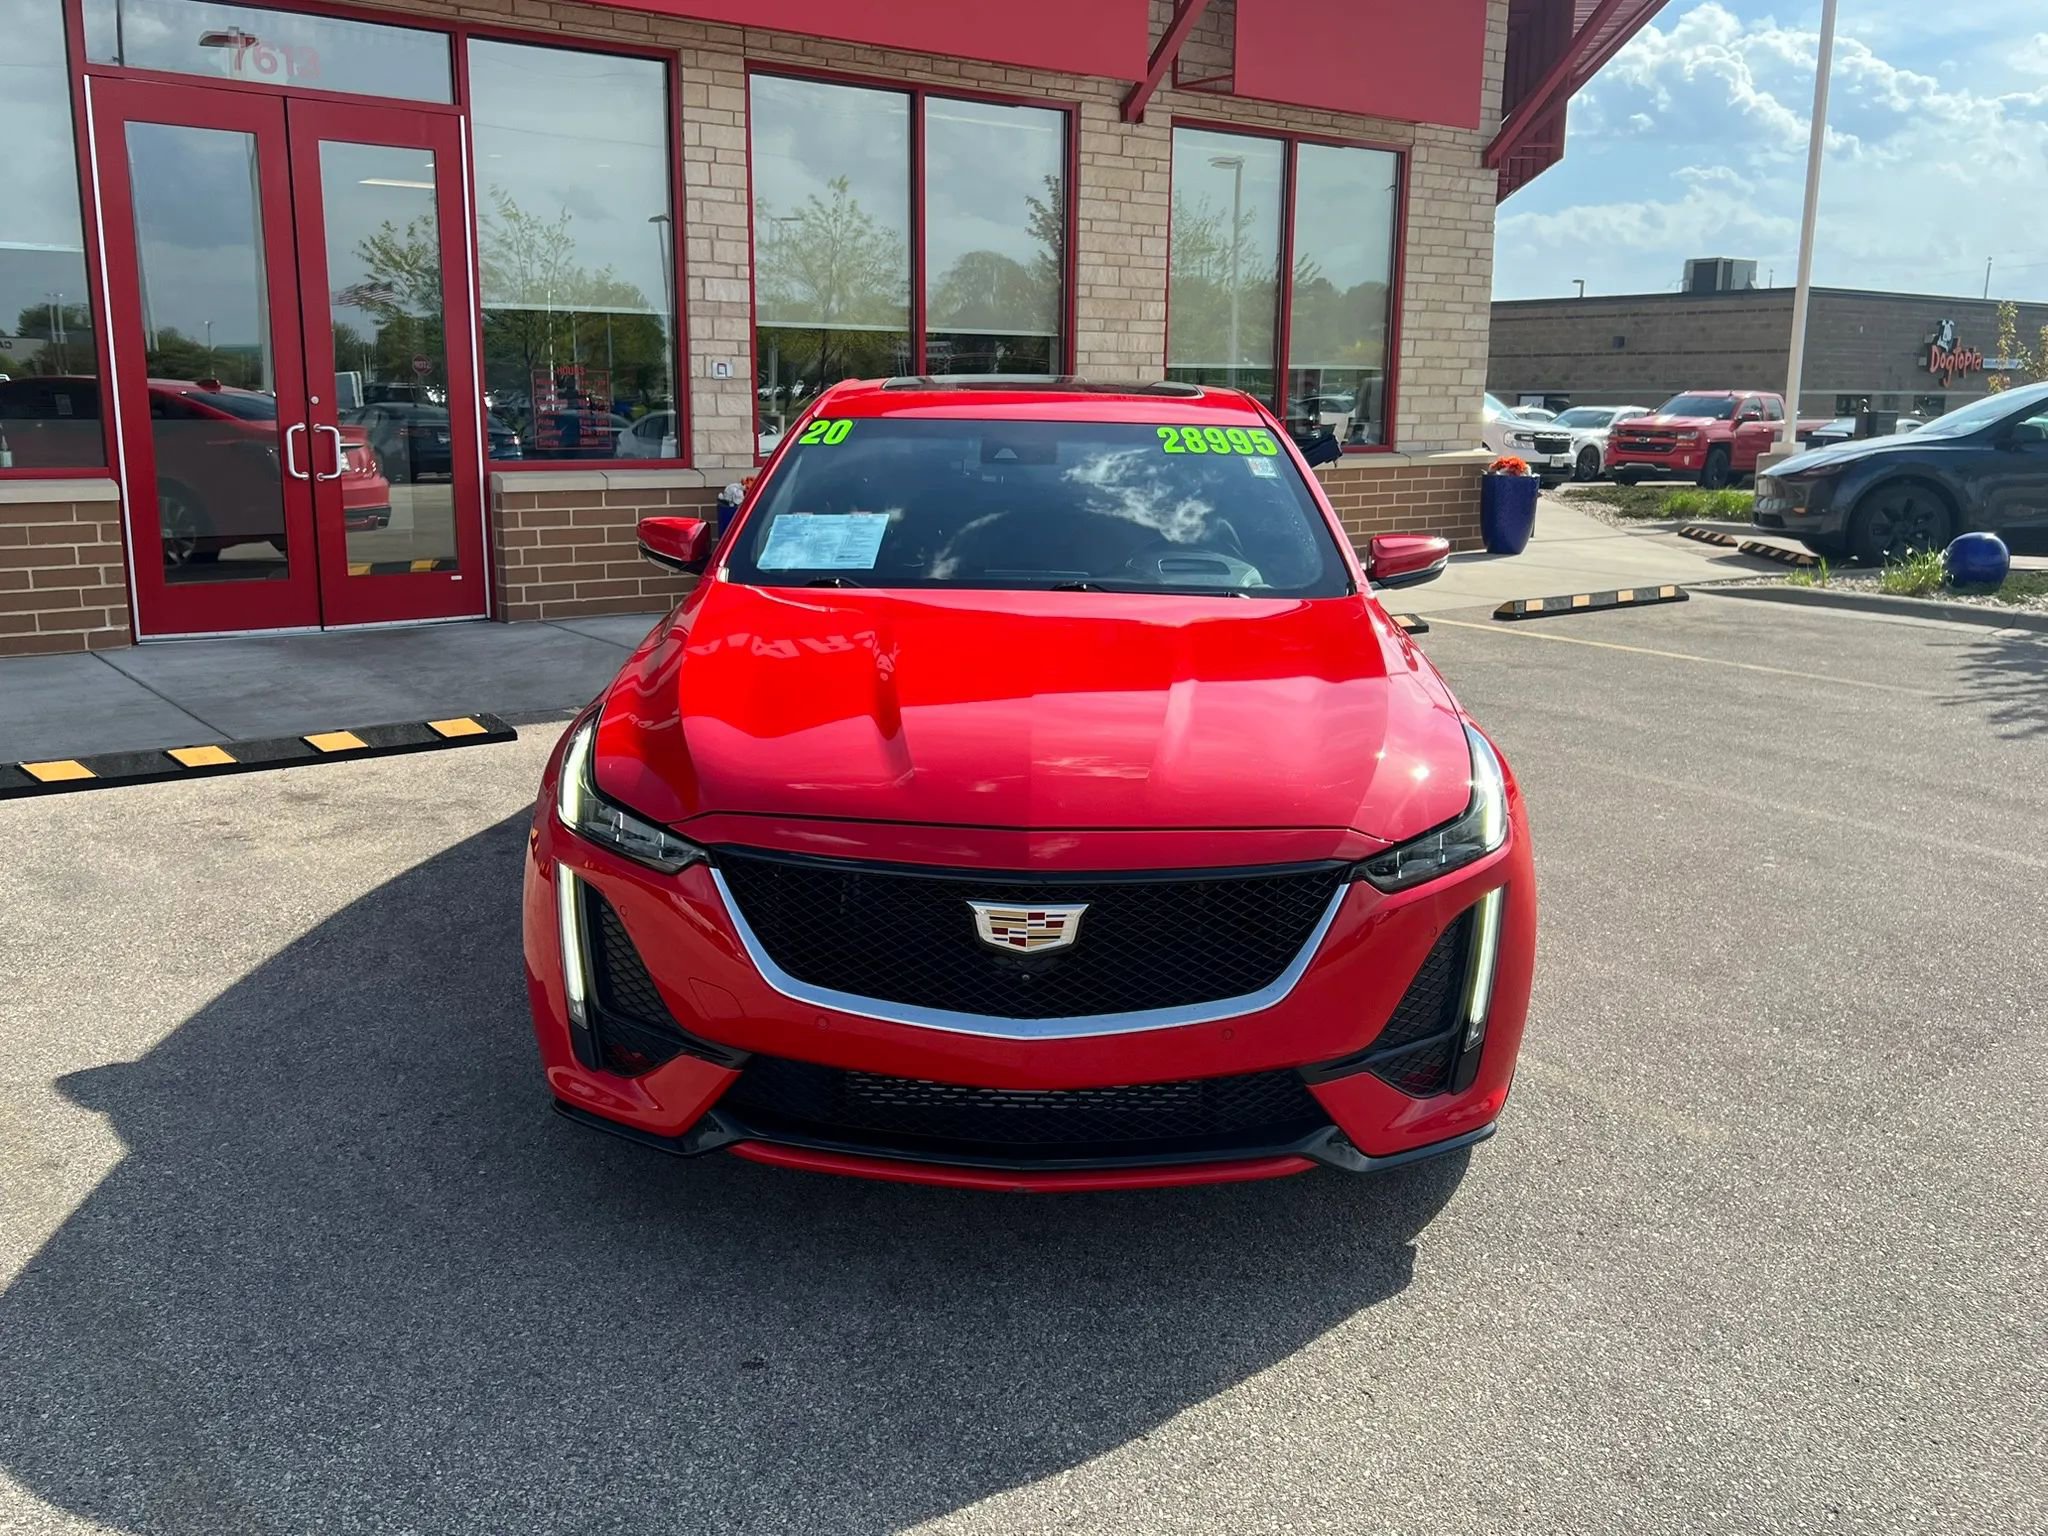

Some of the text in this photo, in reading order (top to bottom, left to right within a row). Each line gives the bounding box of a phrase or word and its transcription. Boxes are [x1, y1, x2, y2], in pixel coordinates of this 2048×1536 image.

[557, 366, 585, 376] HOURS
[1930, 336, 1983, 388] Dogtopia
[799, 419, 854, 445] 20
[1156, 426, 1279, 456] 28995
